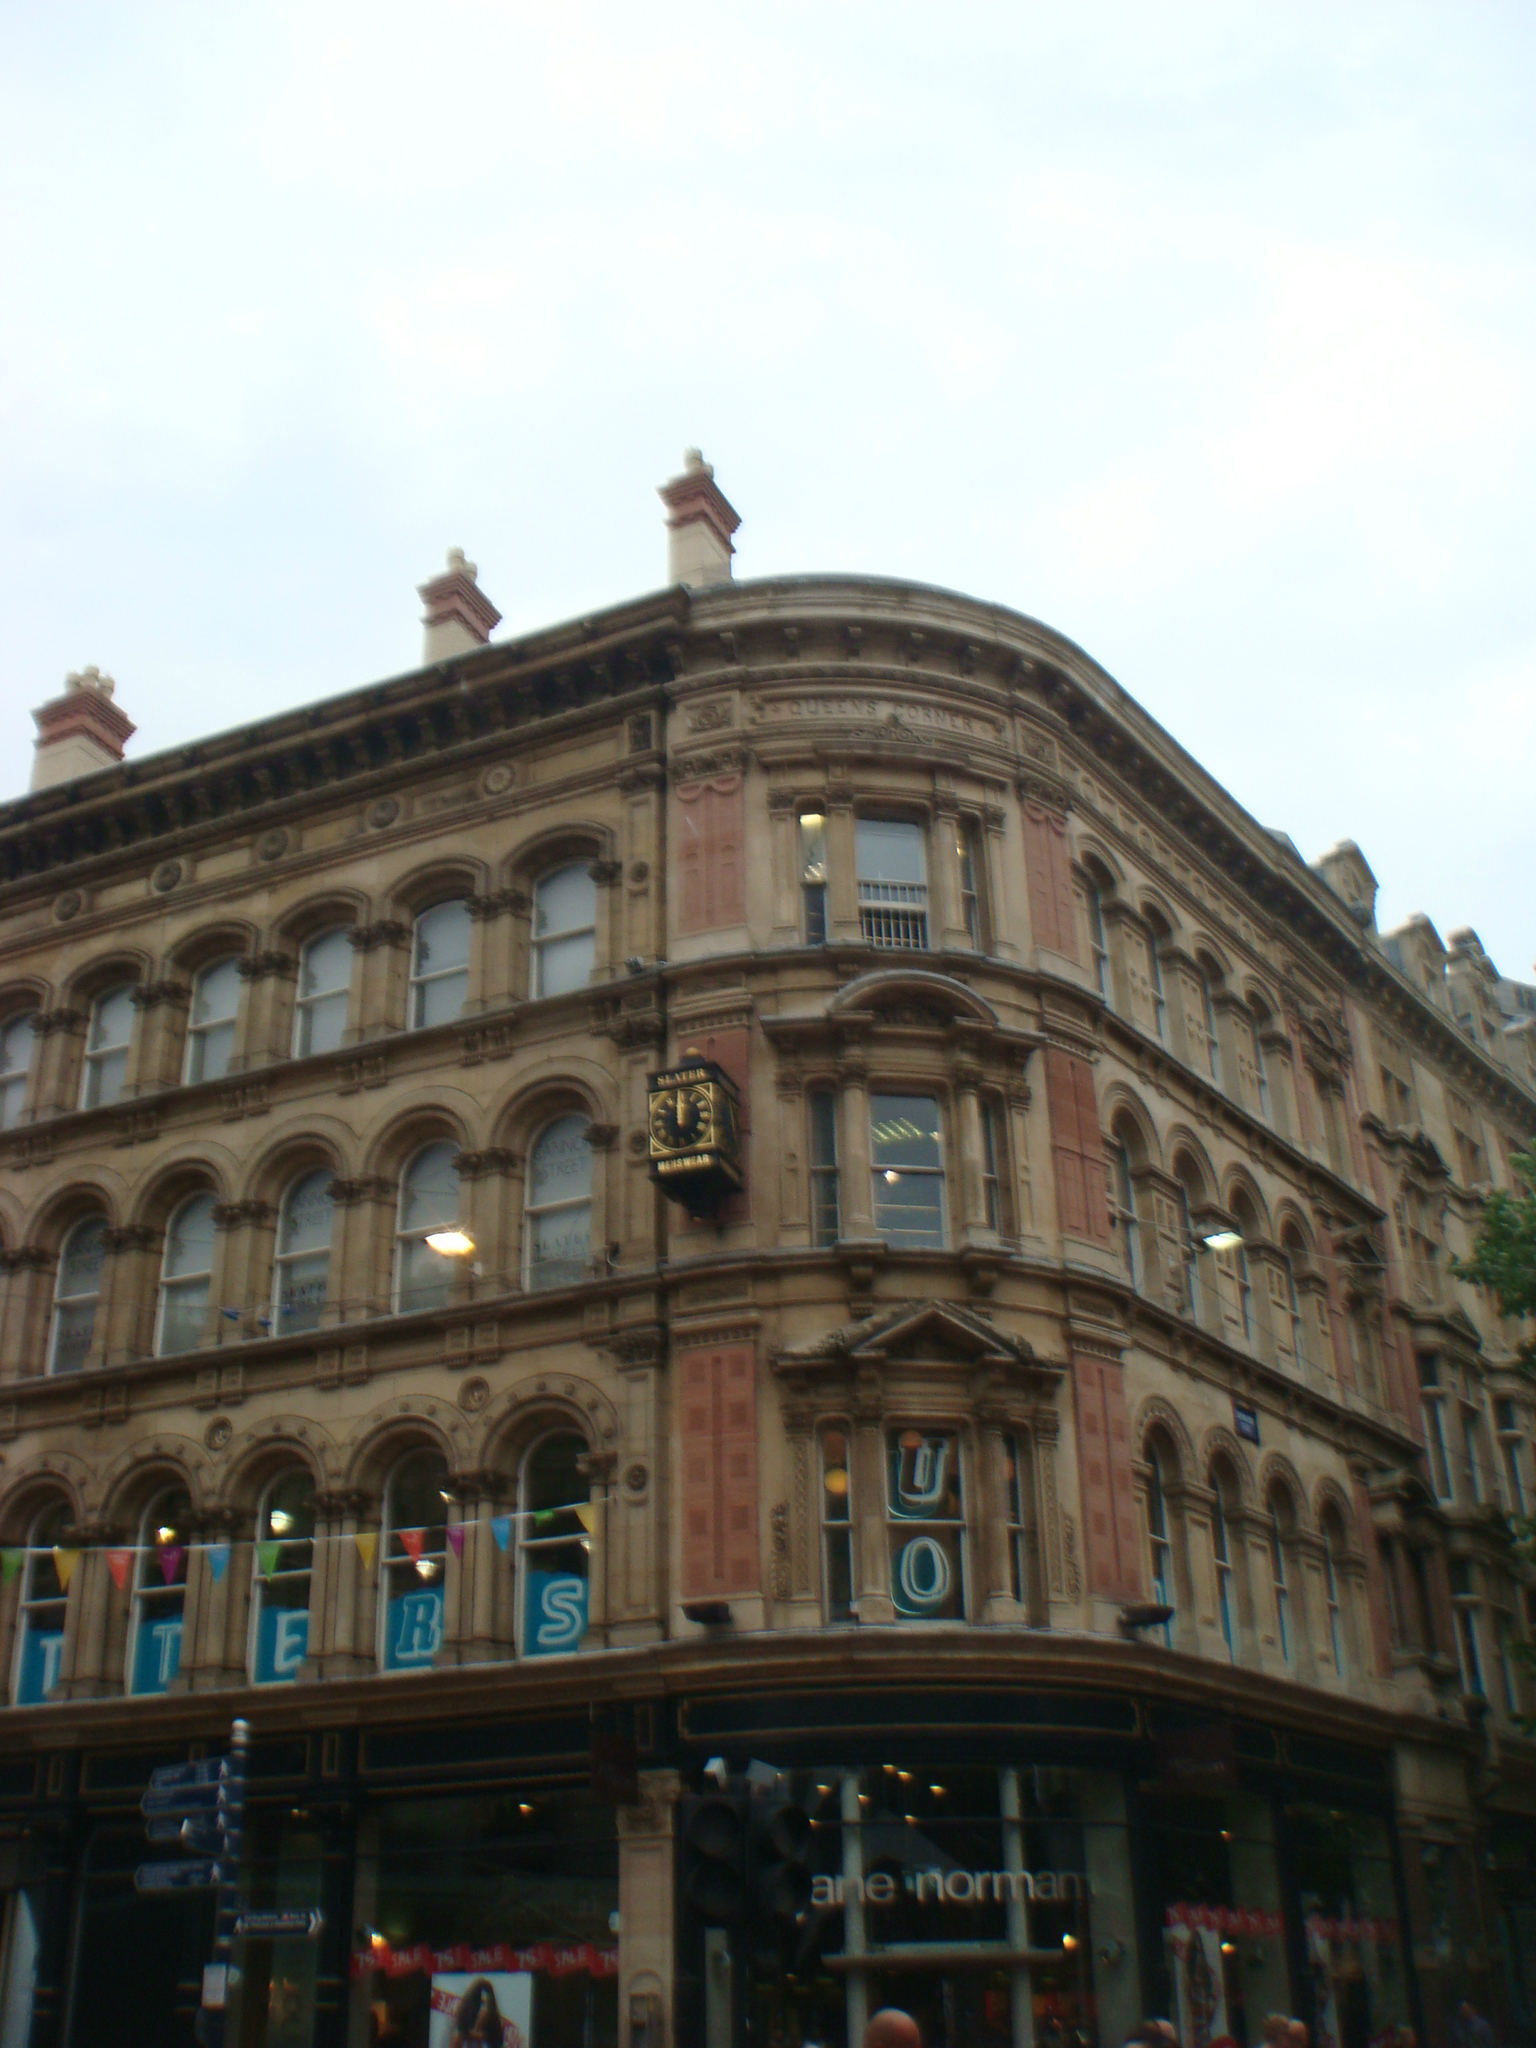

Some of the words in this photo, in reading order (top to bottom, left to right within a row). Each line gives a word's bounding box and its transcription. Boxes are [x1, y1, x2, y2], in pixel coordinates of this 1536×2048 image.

[789, 698, 878, 717] QUEENS
[894, 702, 974, 734] CORNER
[657, 1068, 706, 1086] SLATER
[657, 1153, 710, 1172] MENSWEAR
[811, 1872, 895, 1905] ane
[915, 1870, 1079, 1903] norman
